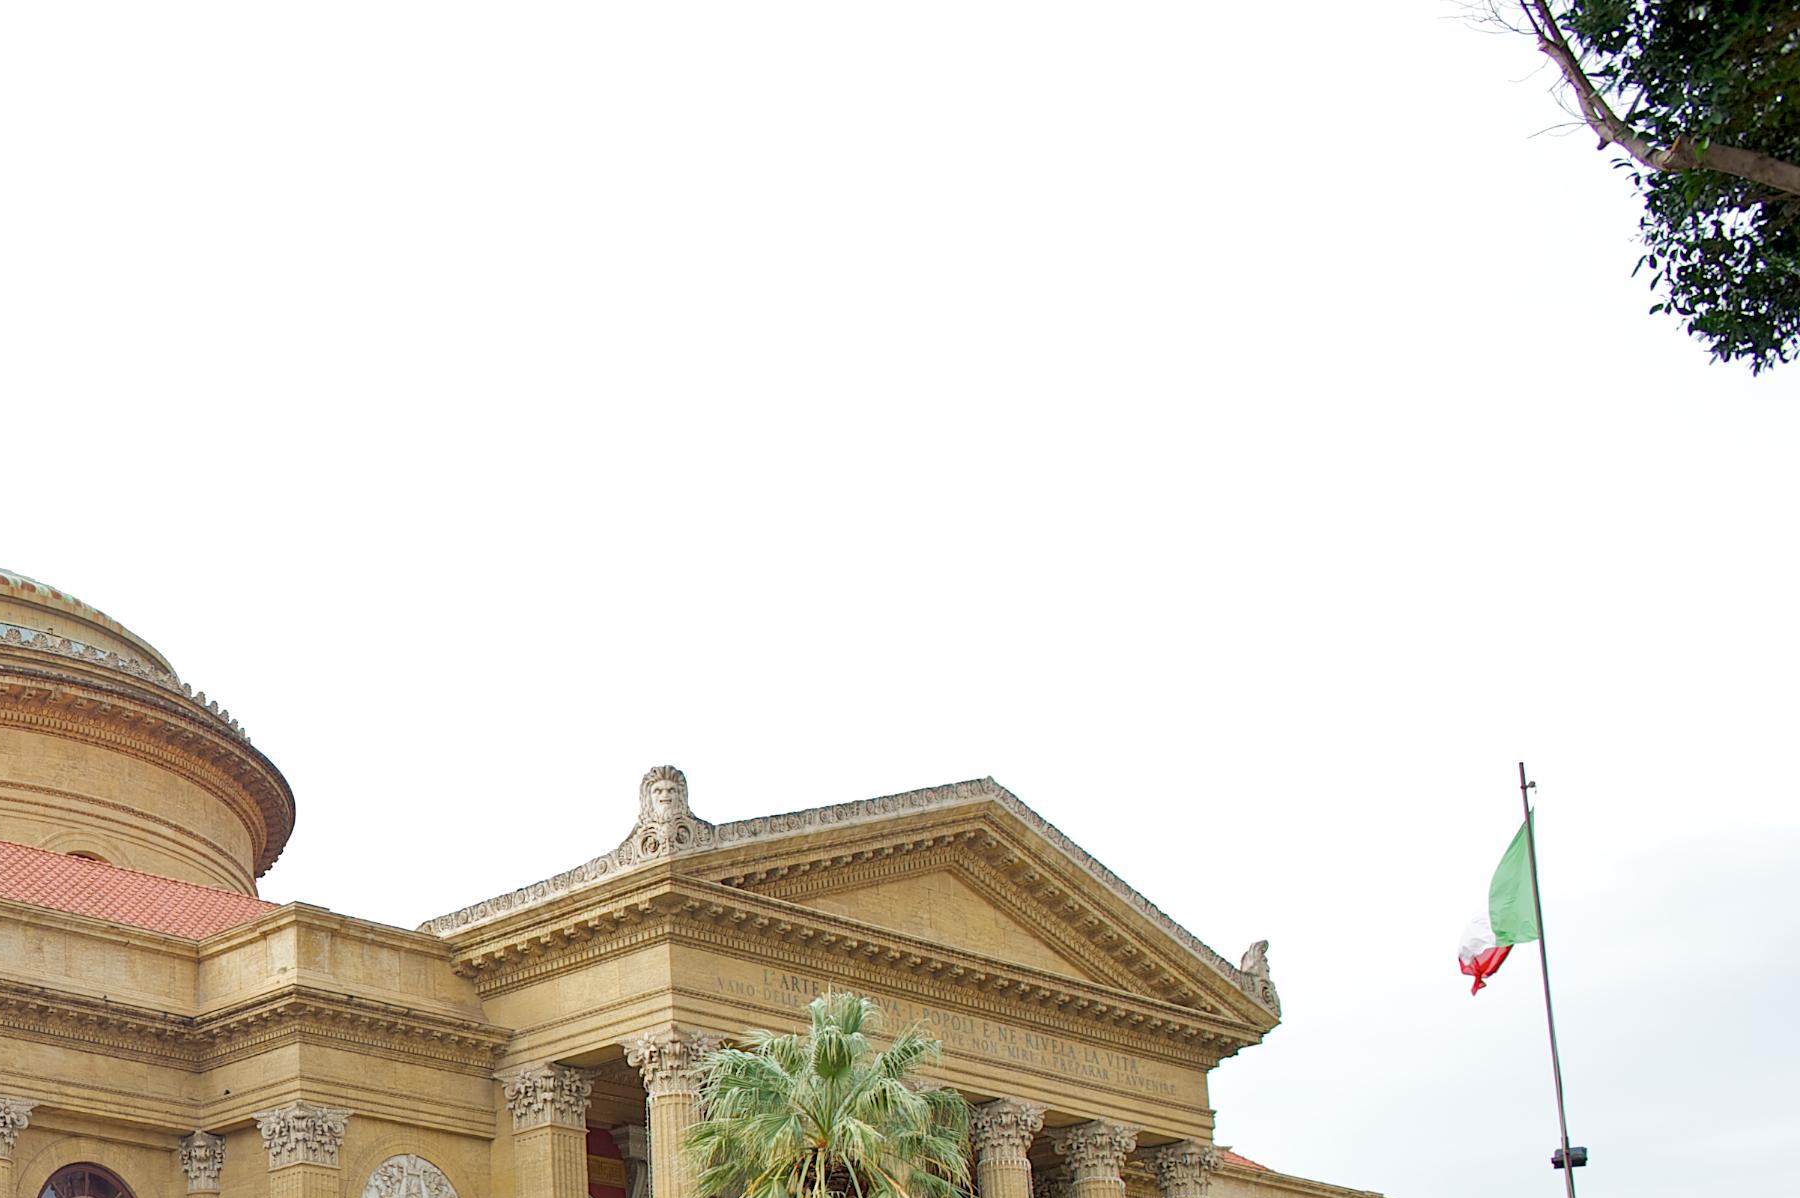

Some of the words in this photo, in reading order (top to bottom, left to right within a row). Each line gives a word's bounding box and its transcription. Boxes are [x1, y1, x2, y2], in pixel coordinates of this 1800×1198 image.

[717, 976, 756, 997] VANO
[941, 1030, 965, 1046] OVE
[972, 1037, 998, 1055] NON
[1007, 1045, 1034, 1063] MIRI
[922, 1007, 975, 1034] POPOLI
[983, 1022, 991, 1038] E
[998, 1026, 1017, 1045] NE
[1025, 1033, 1076, 1060] RIVELA
[1084, 1047, 1100, 1065] LA
[1105, 1052, 1139, 1075] VITA
